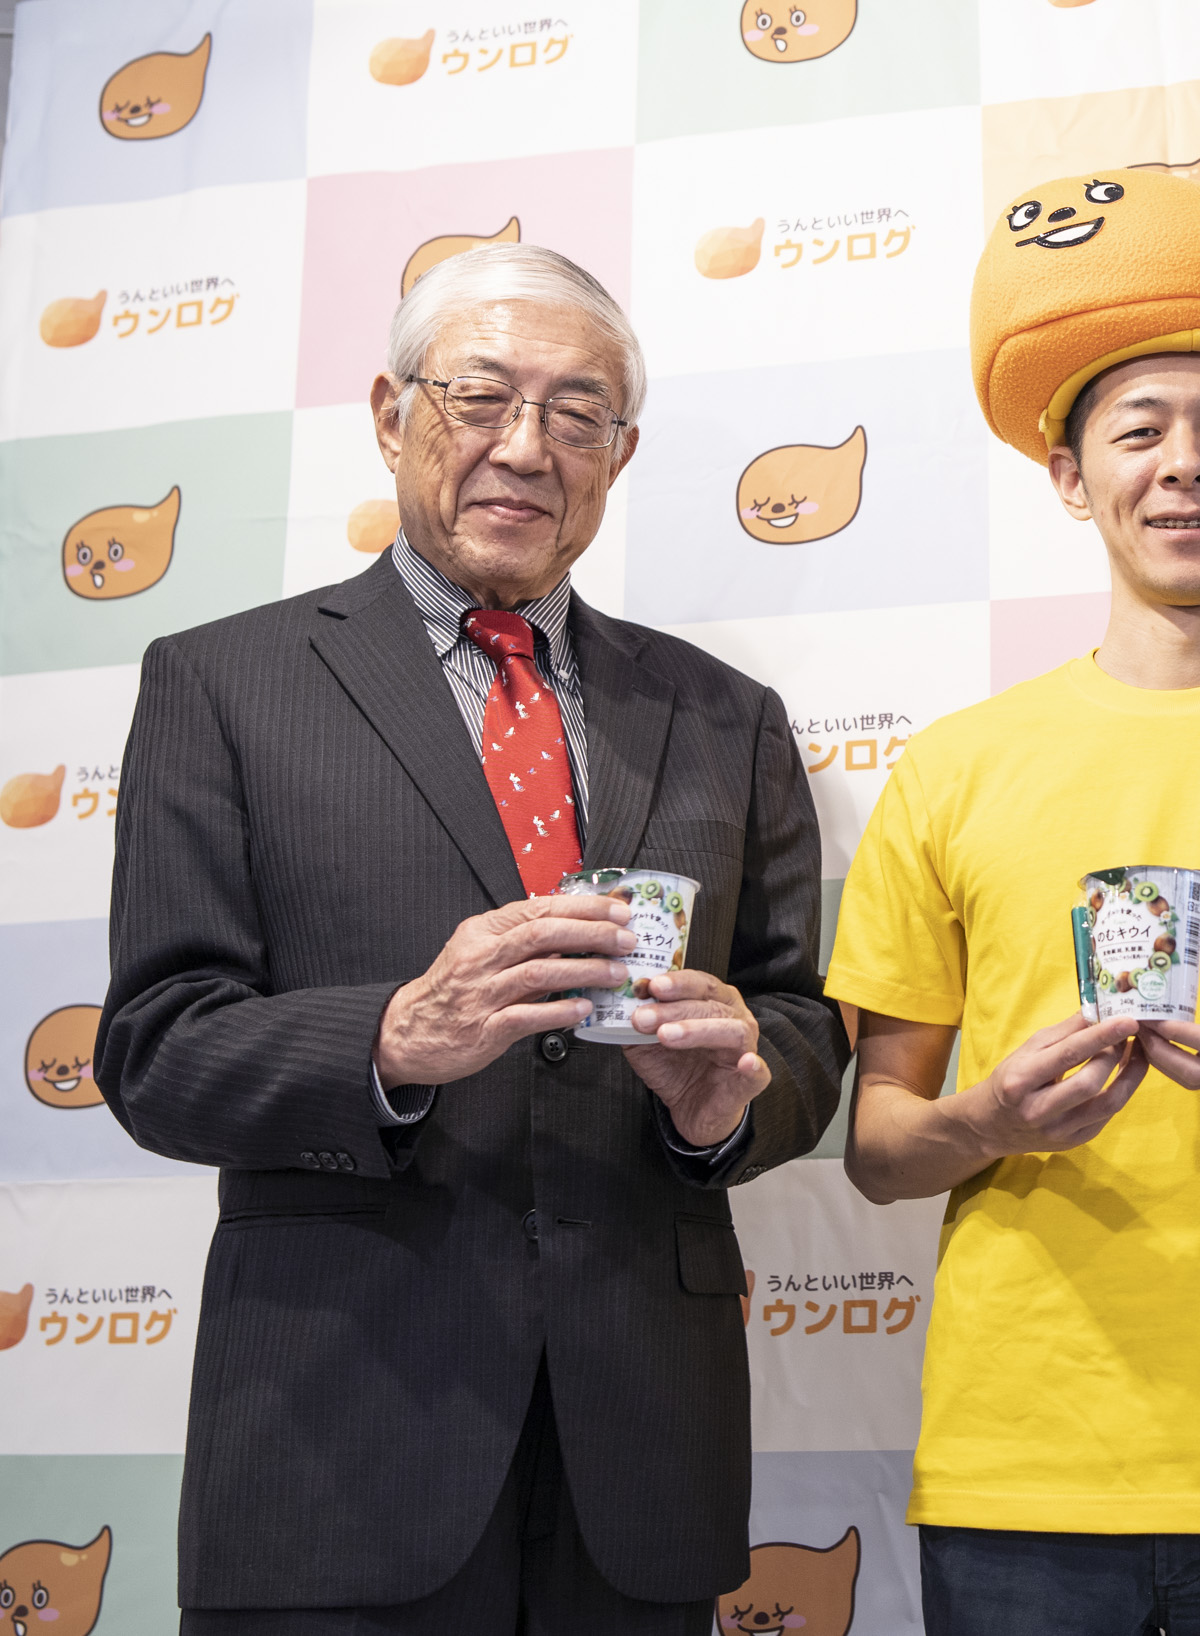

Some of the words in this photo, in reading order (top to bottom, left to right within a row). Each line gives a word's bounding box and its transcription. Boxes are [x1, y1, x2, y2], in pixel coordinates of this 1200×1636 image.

[447, 18, 568, 43] うんといい世界へ
[442, 34, 574, 75] ウンログ
[777, 207, 909, 233] うんといい世界へ
[774, 225, 916, 269] ウンログ
[118, 276, 235, 304] うんといい世界へ
[113, 293, 240, 338] ウンログ
[791, 713, 912, 735] んといい世界へ
[77, 765, 120, 782] うんと
[1098, 925, 1151, 942] のむキウイ
[45, 1285, 173, 1304] うんといい世界へ
[767, 1271, 914, 1292] うんといい世界へ
[40, 1308, 178, 1346] ウンログ
[763, 1295, 921, 1337] ウンログ
